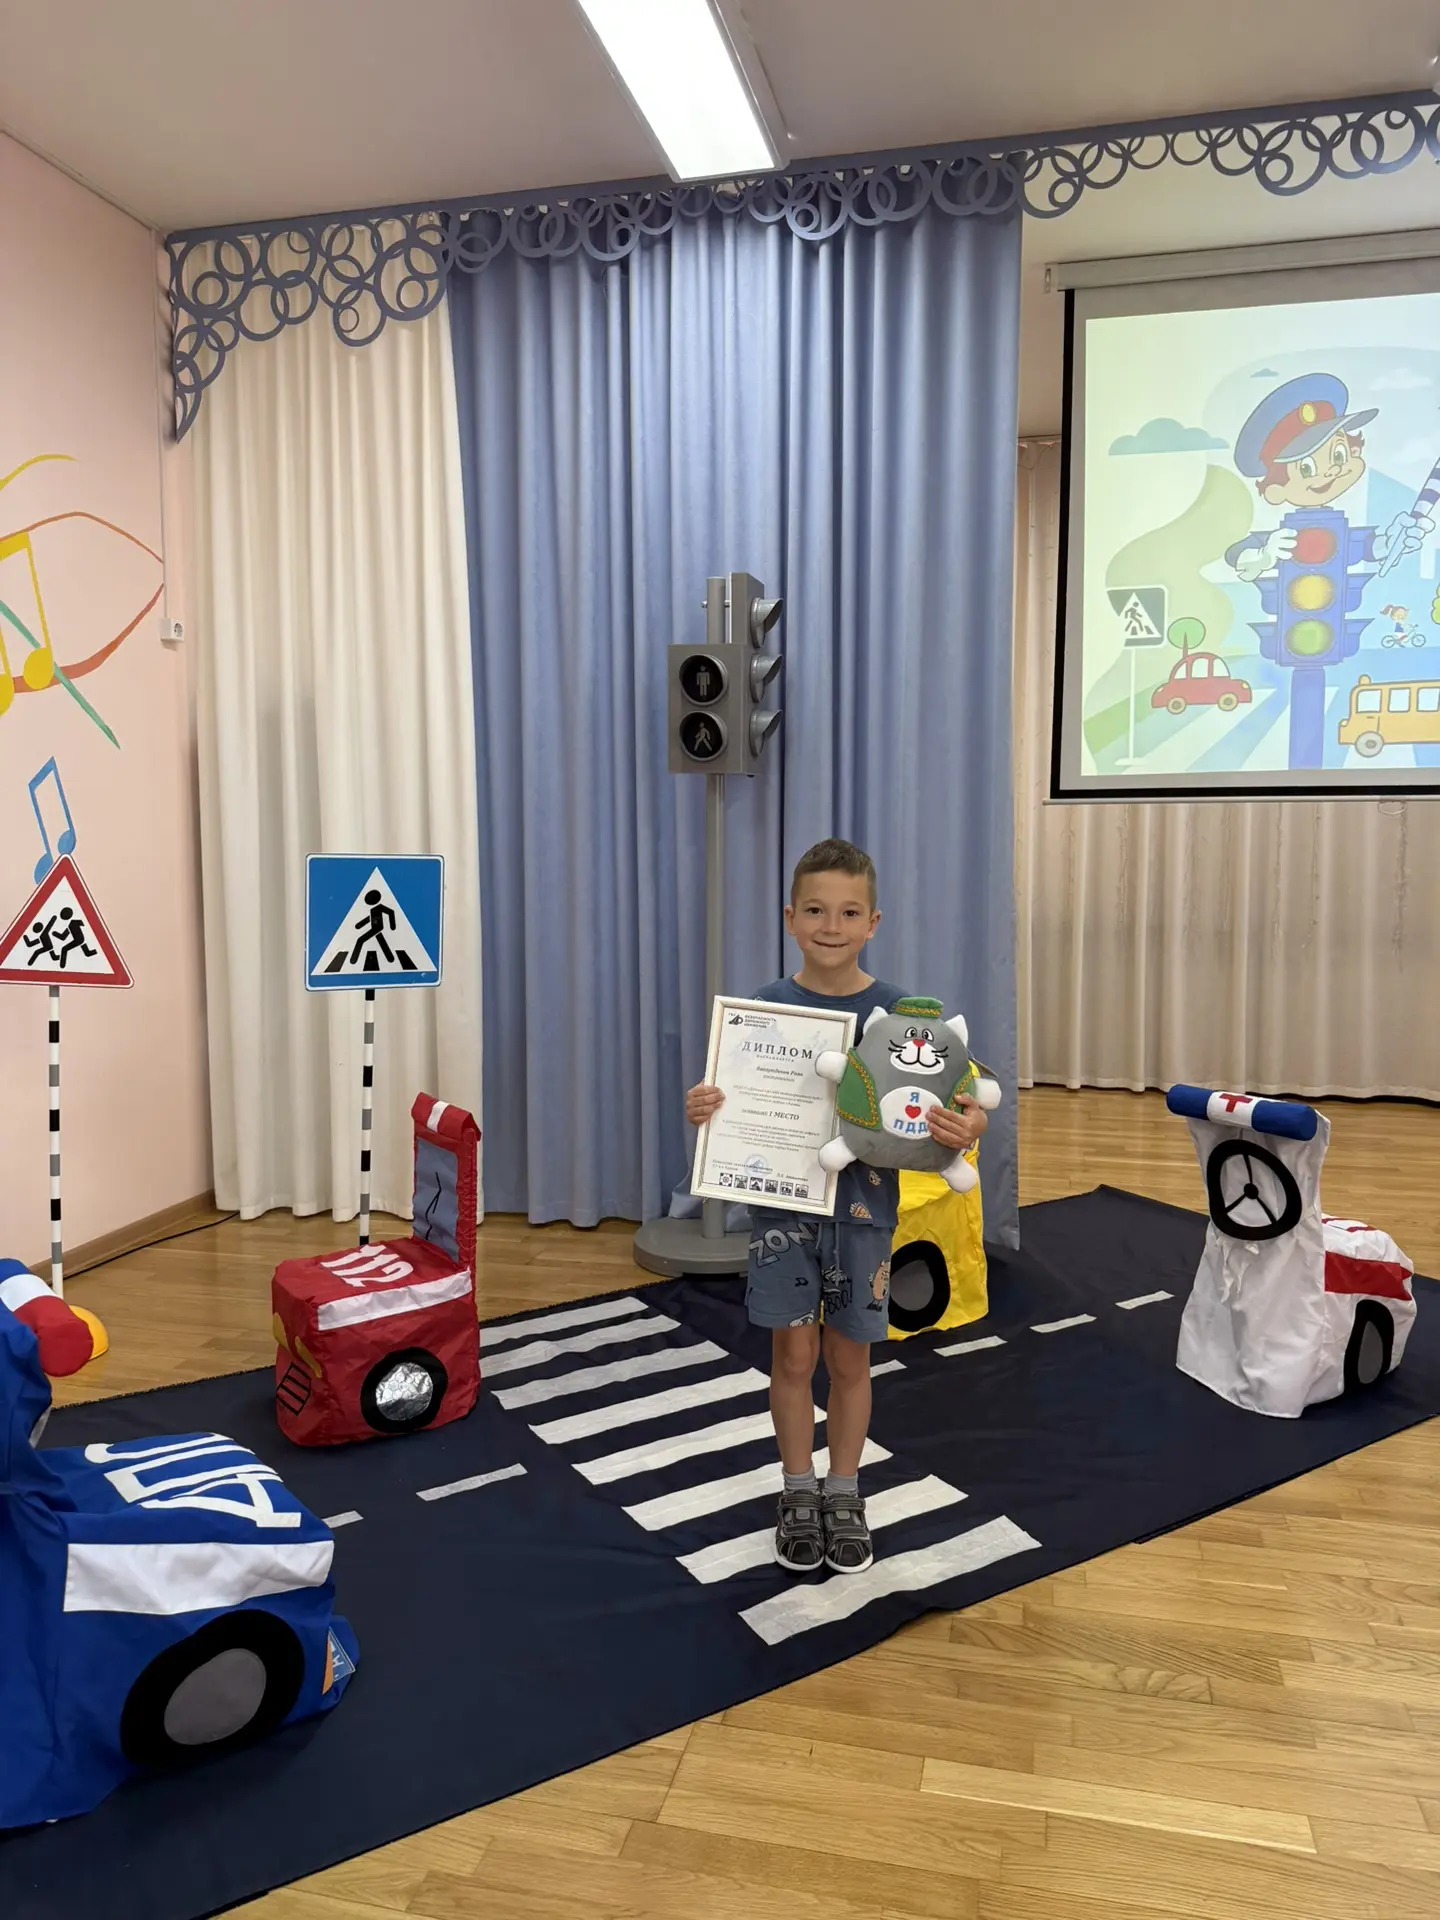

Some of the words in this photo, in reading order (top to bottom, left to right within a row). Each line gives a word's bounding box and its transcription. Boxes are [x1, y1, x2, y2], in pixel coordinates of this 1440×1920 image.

[742, 1041, 813, 1059] ДИПЛОМ
[910, 1092, 920, 1103] Я
[774, 1111, 800, 1120] МЕСТО
[893, 1119, 928, 1134] ПДД
[320, 1245, 413, 1287] 112
